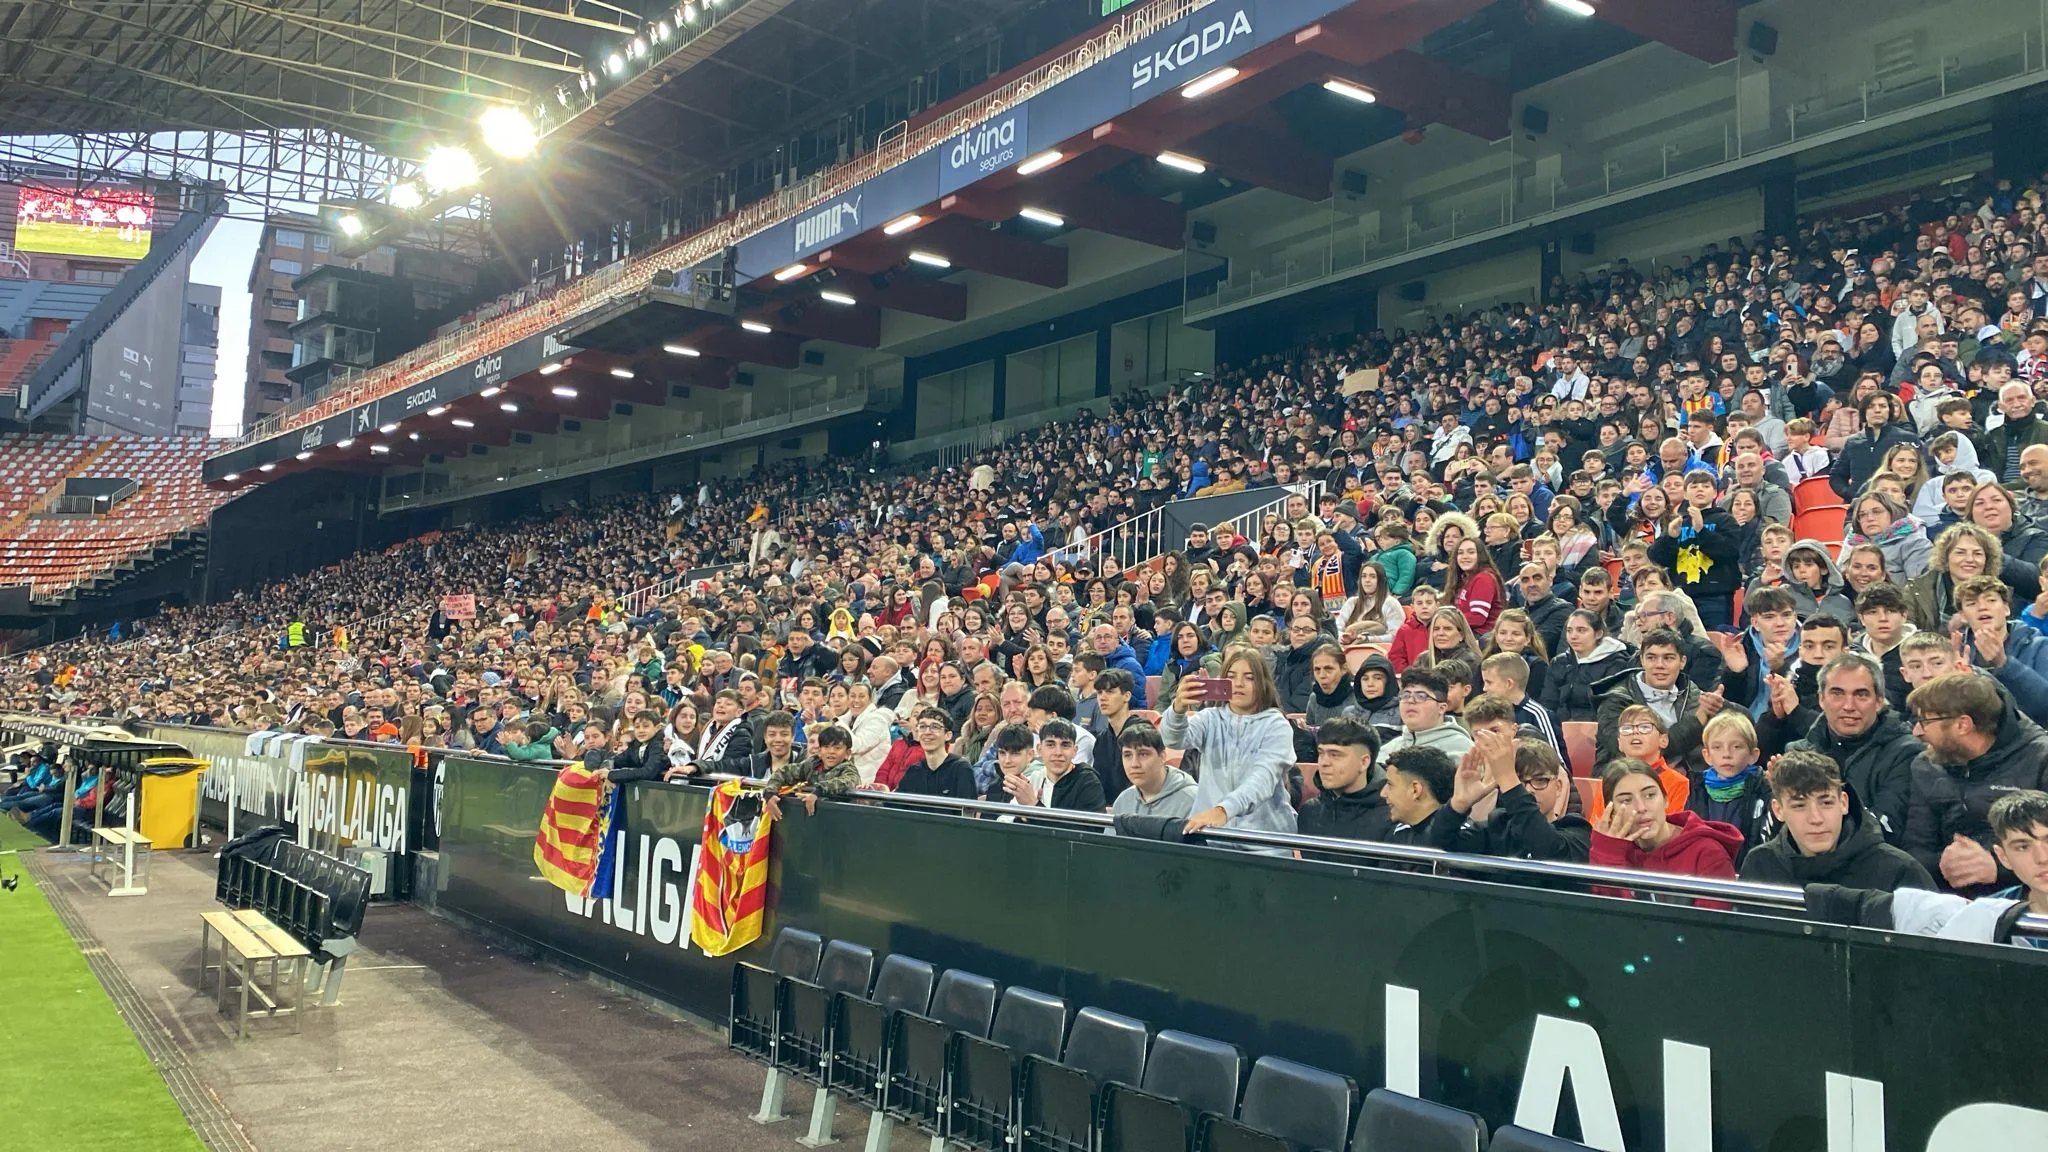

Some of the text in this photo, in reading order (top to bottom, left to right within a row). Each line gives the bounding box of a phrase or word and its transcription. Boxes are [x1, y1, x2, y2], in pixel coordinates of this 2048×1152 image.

[951, 118, 1015, 168] divina
[980, 147, 1014, 171] seguros
[795, 203, 842, 253] PUMA
[475, 355, 502, 379] divina
[340, 777, 406, 856] LALIGA
